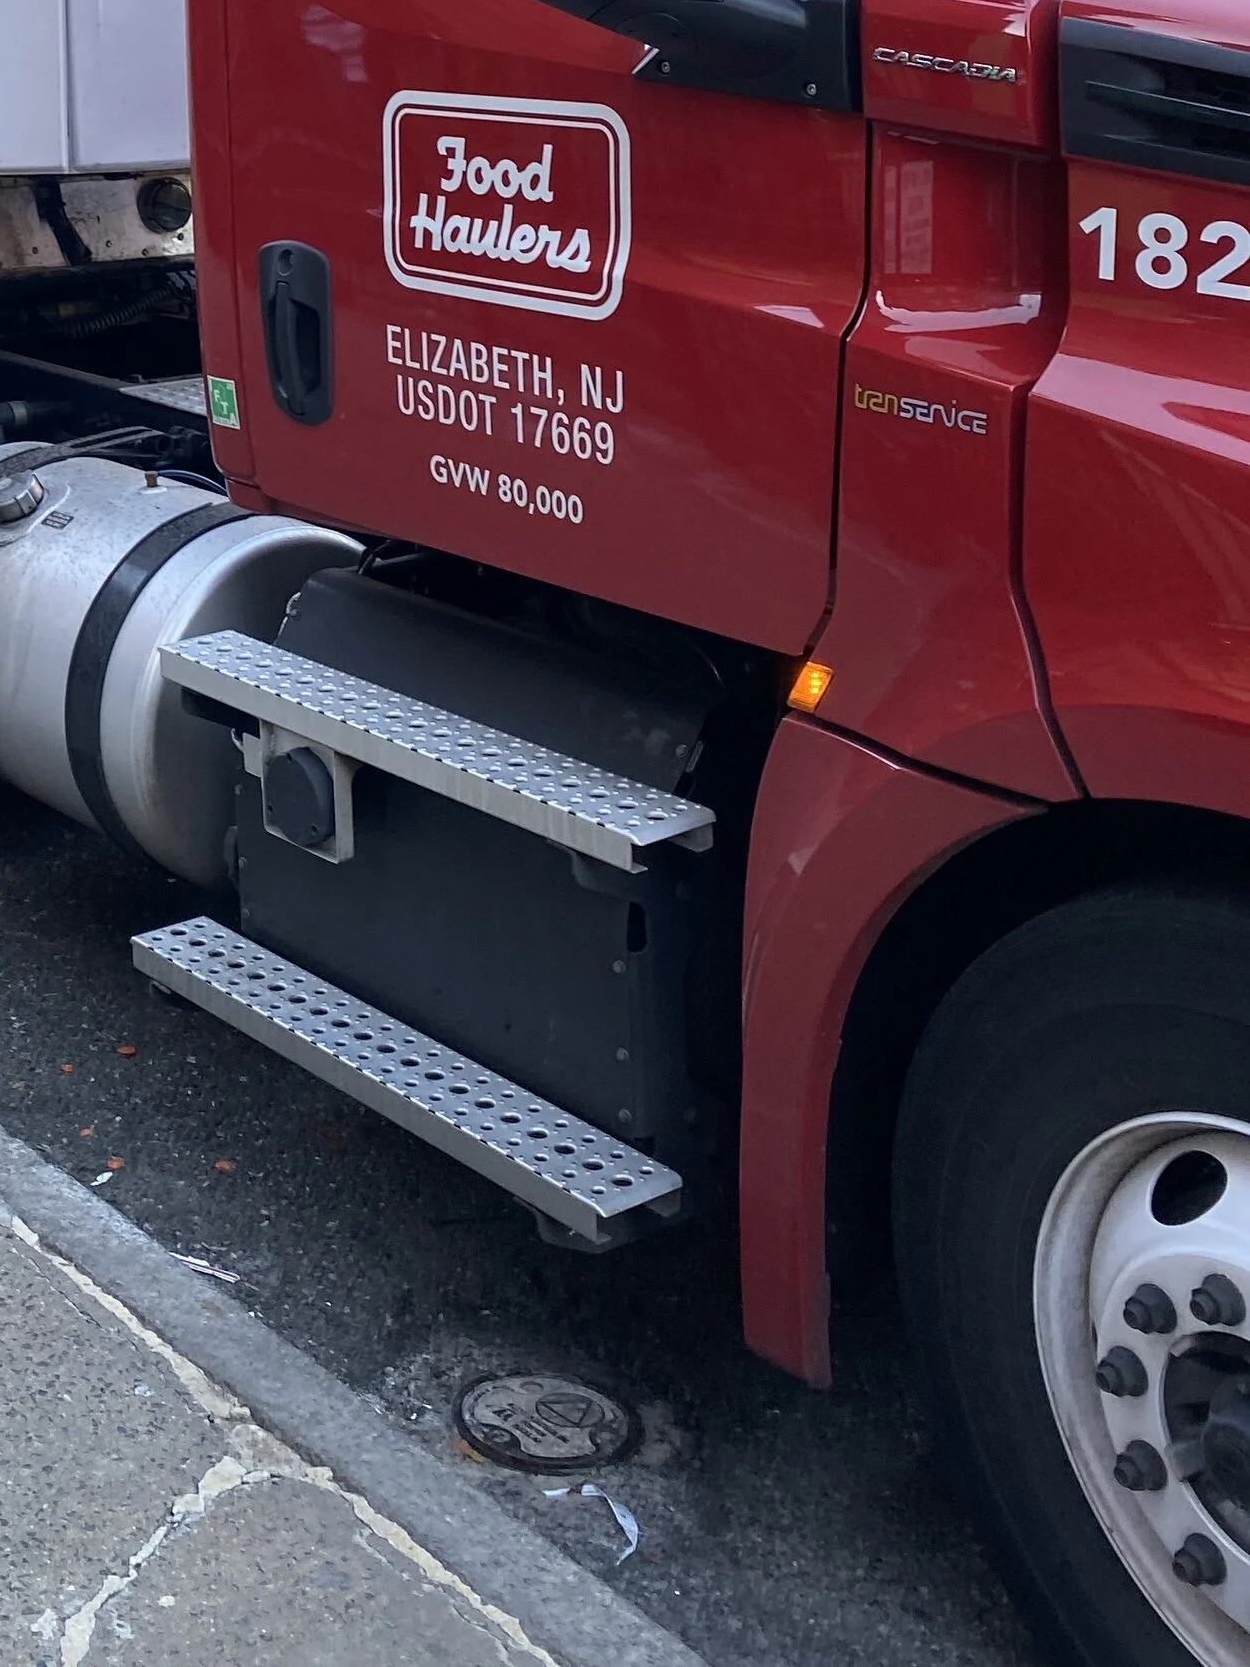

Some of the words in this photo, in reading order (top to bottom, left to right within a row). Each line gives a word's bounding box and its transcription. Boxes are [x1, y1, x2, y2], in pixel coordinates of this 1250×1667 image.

[872, 46, 1016, 82] CASCADIA
[436, 135, 554, 203] Food
[409, 193, 592, 274] Haulers
[386, 324, 565, 405] ELIZABETH,
[580, 363, 624, 414] NJ
[397, 374, 498, 436] USDOT
[511, 405, 615, 466] 17669
[429, 454, 491, 497] GVW
[497, 474, 585, 525] 80,000
